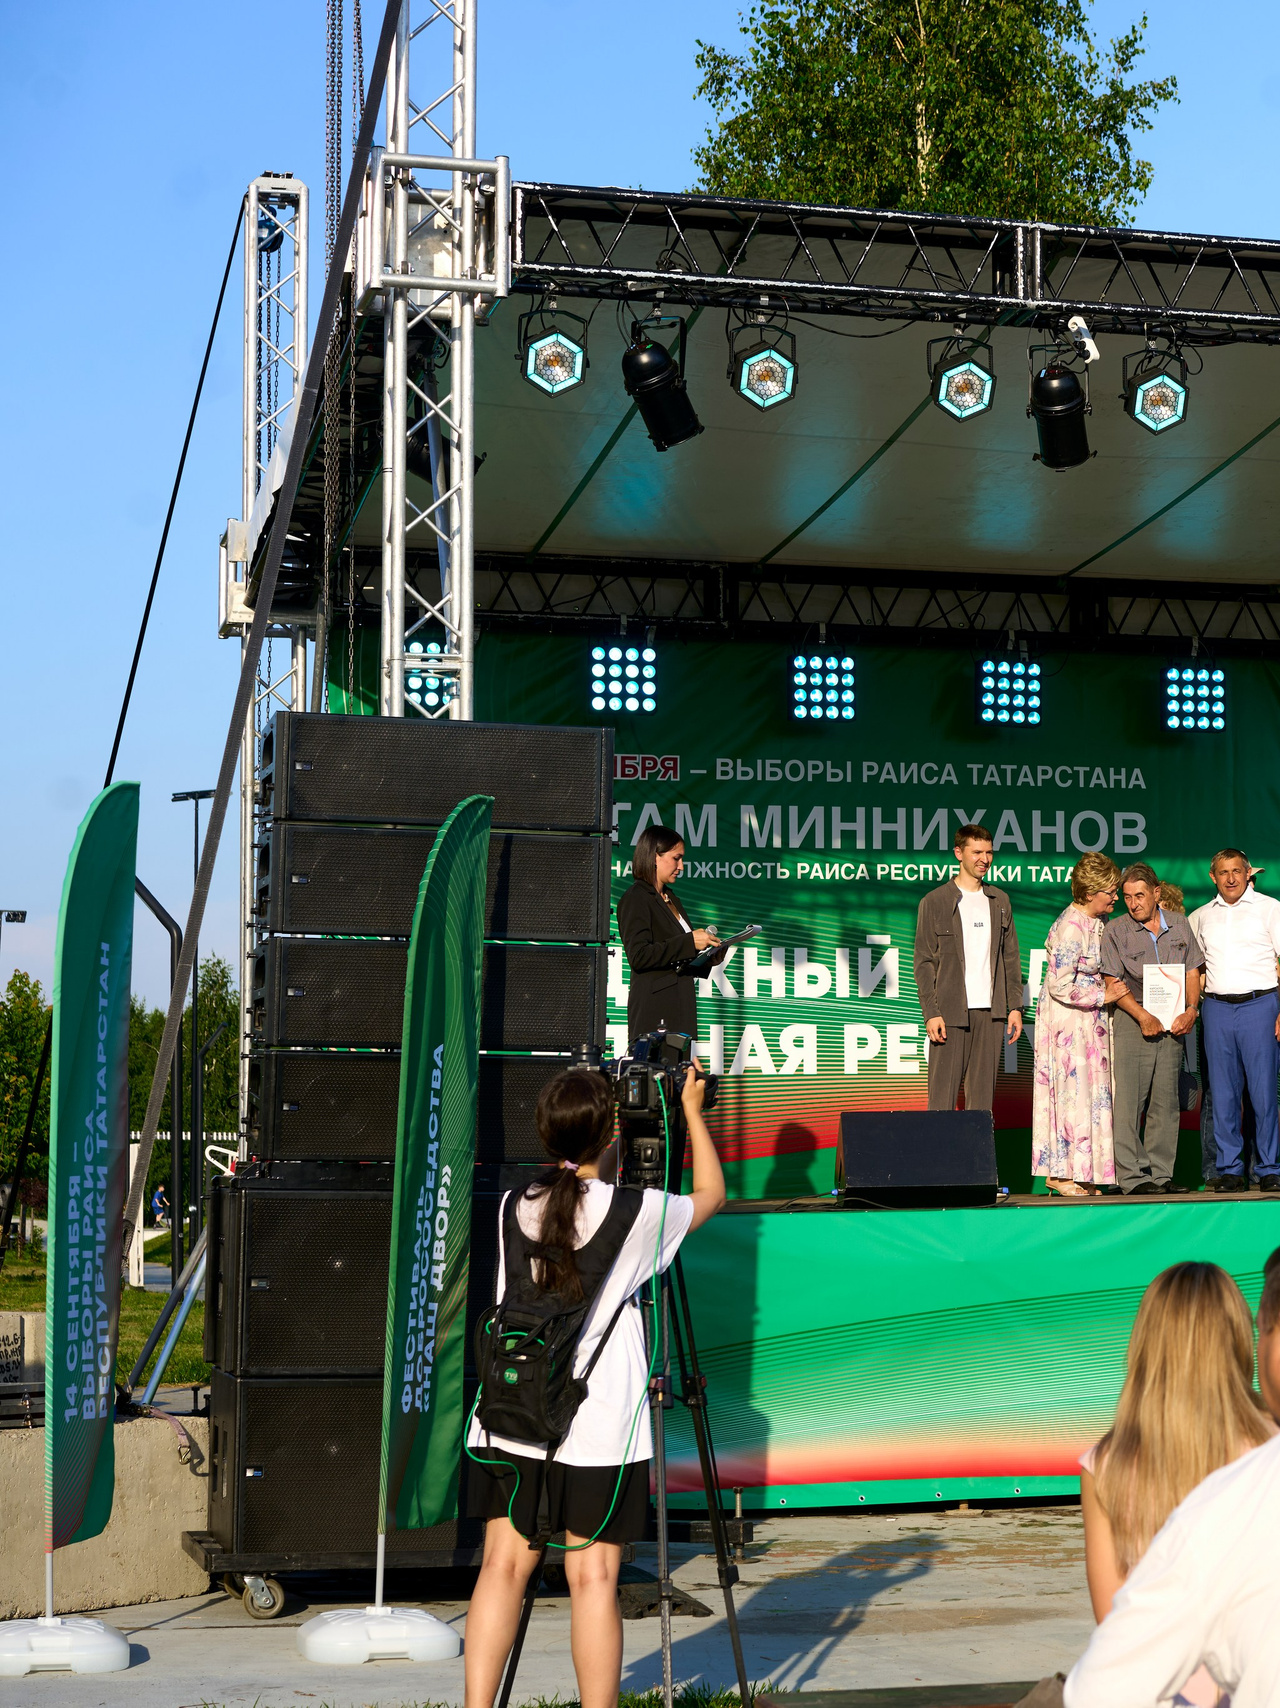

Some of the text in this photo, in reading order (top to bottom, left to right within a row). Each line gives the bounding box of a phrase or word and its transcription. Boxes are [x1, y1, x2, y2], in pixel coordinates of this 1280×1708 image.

[715, 757, 853, 783] ВЫБОРЫ
[862, 760, 959, 785] РАИСА
[966, 763, 1147, 790] ТАТАРСТАНА
[796, 862, 870, 881] РАИСА
[66, 1175, 81, 1372] СЕНТЯБРЯ
[82, 1109, 96, 1420] ВЫБОРЫ РАИСА
[95, 941, 111, 1419] РЕСПУБЛИКИ ТАТАРСТАН
[415, 1043, 444, 1412] ДОБРОСОСЕДСТВА
[423, 1164, 452, 1413] «НАШ ДВОР»
[64, 1383, 78, 1424] 14
[402, 1185, 425, 1414] ФЕСТИВАЛЬ
